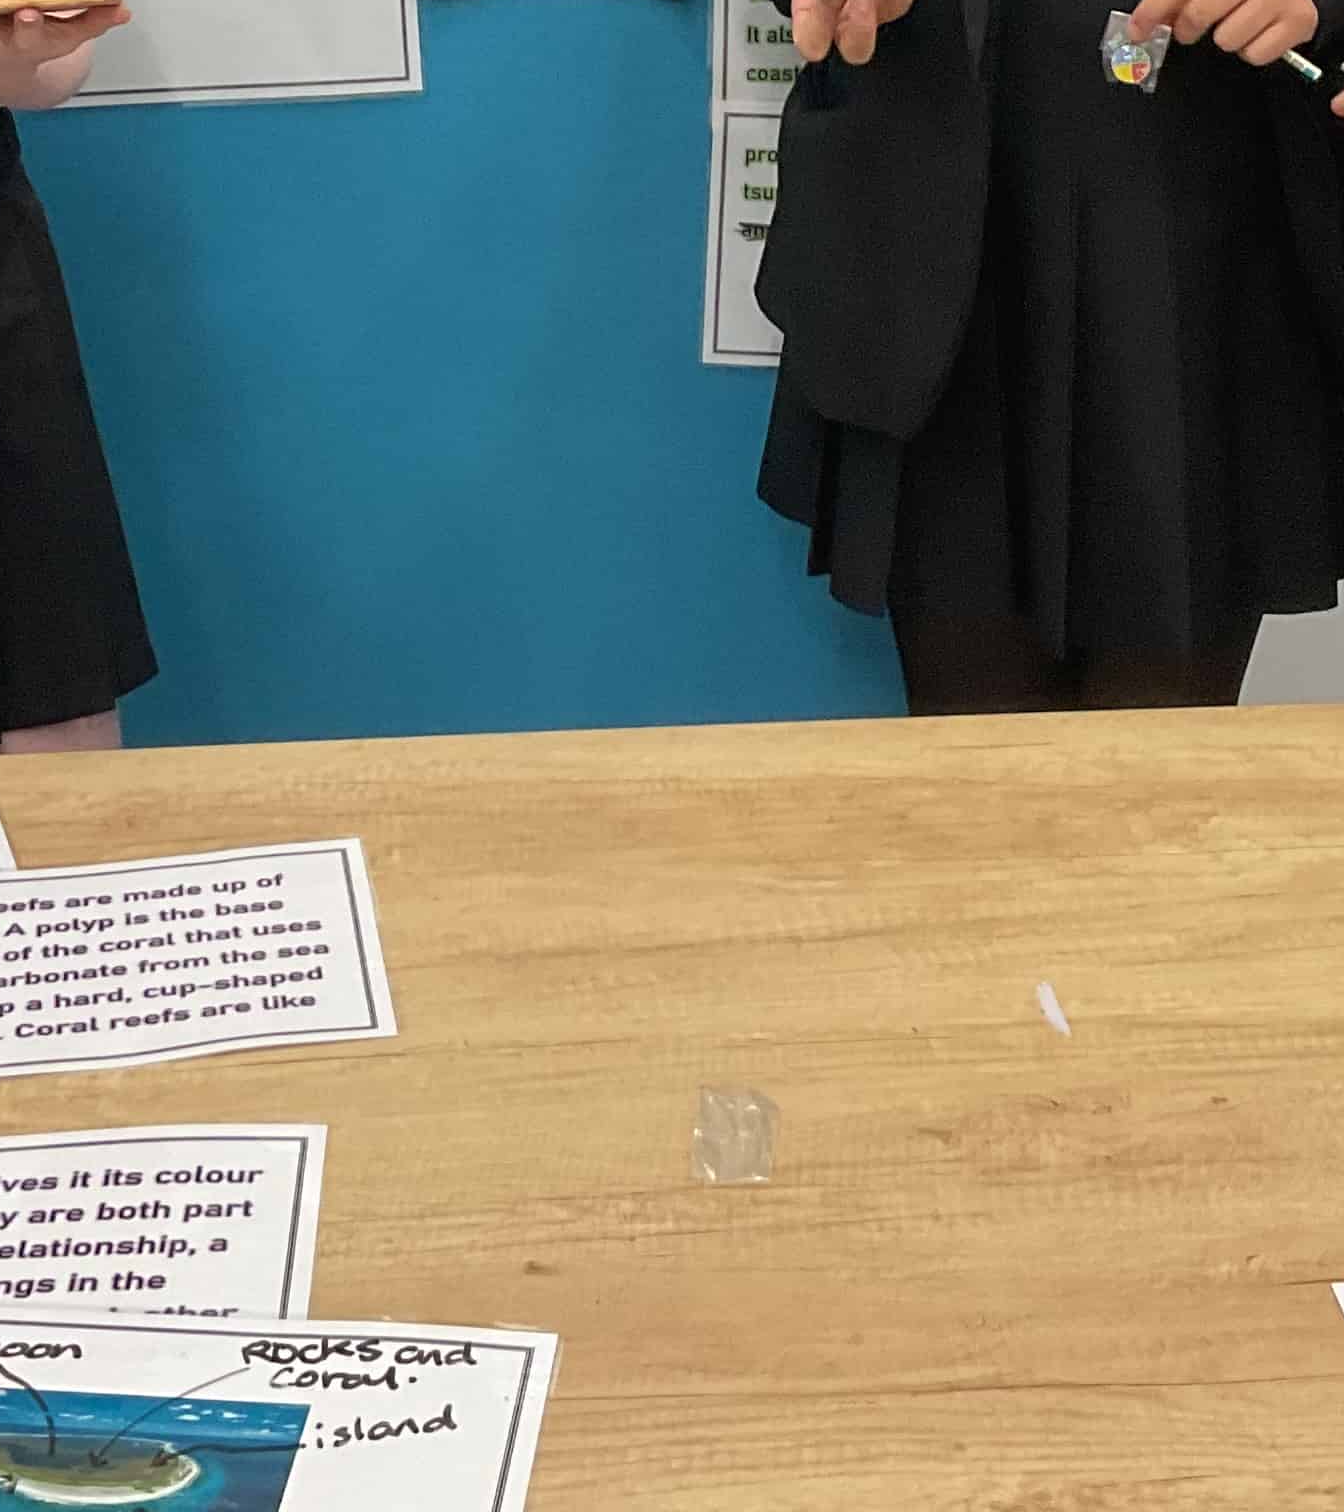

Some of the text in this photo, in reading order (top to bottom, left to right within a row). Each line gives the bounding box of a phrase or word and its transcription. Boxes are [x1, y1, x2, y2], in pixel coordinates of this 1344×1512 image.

[64, 895, 113, 909] are
[123, 883, 202, 903] made
[212, 880, 247, 895] up
[256, 872, 283, 888] of
[2, 946, 33, 963] of
[41, 943, 89, 959] the
[98, 932, 176, 953] coral
[184, 926, 242, 944] that
[252, 920, 322, 937] uses
[69, 1170, 92, 1189] it
[101, 1168, 143, 1187] its
[154, 1165, 264, 1185] colour
[394, 1341, 477, 1366] and
[316, 1404, 458, 1449] island
